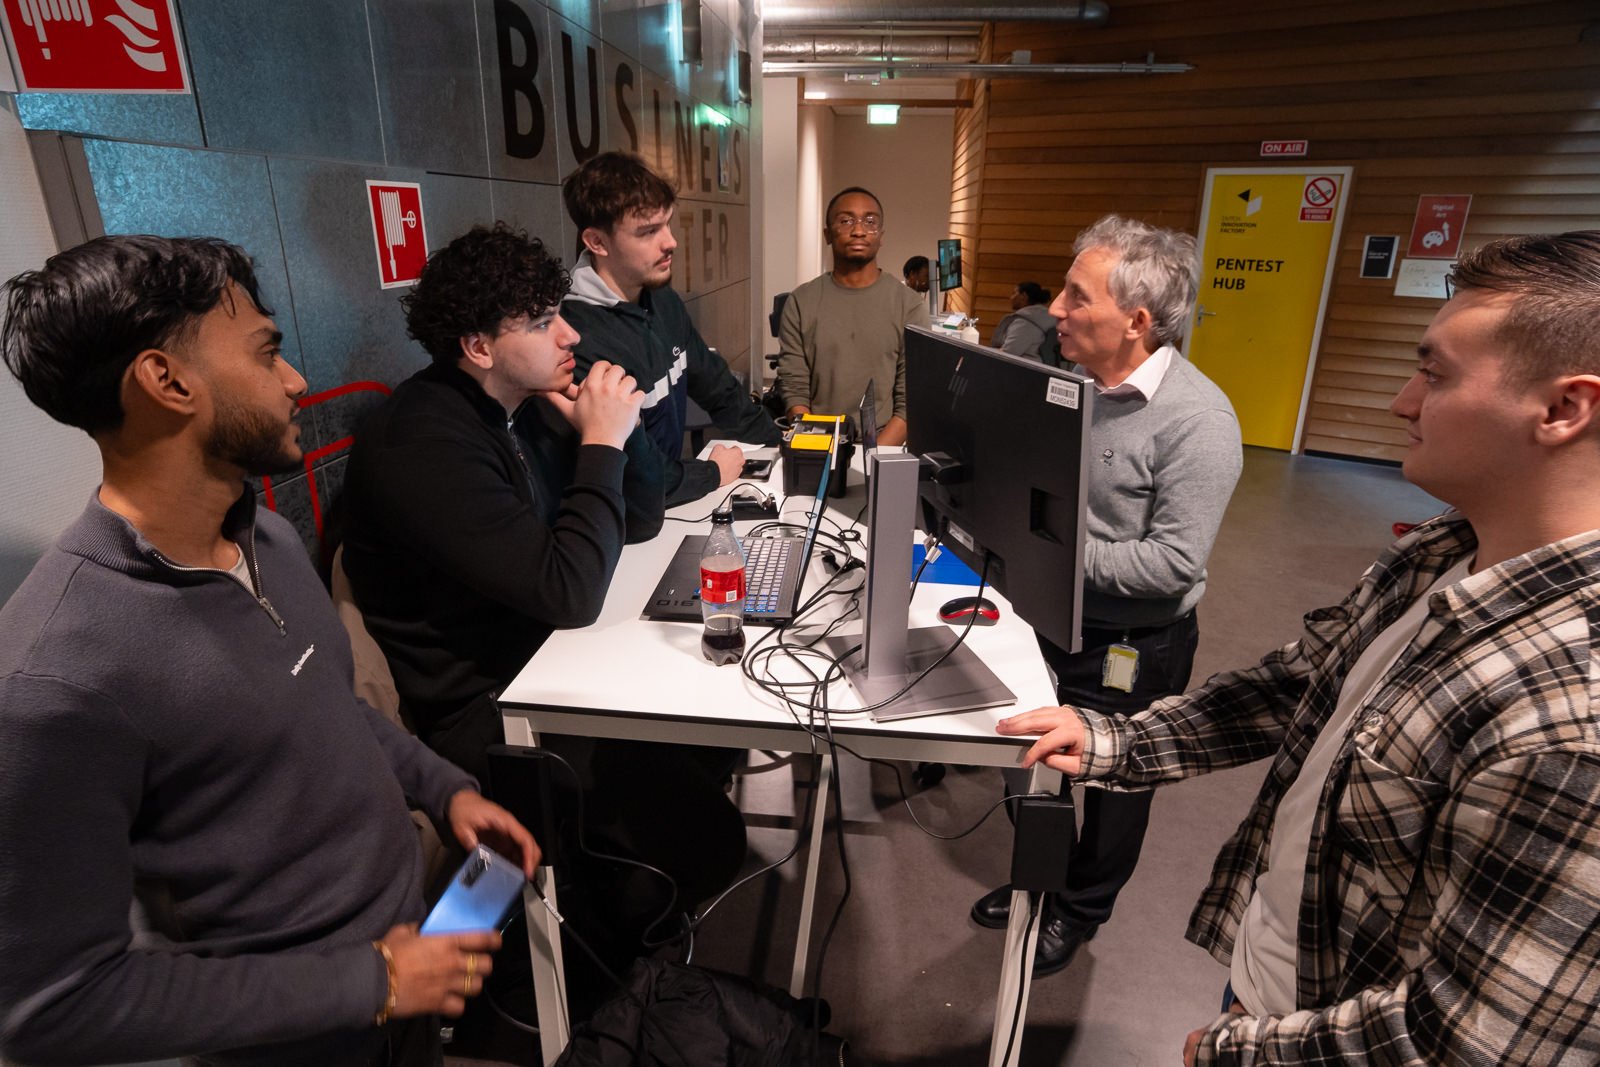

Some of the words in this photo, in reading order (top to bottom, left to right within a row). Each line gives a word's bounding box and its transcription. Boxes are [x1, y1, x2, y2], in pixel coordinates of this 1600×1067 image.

[494, 0, 742, 196] BUSINES
[1265, 143, 1282, 153] ON
[1284, 143, 1303, 153] AIR
[1216, 258, 1284, 272] PENTEST
[1213, 277, 1246, 290] HUB
